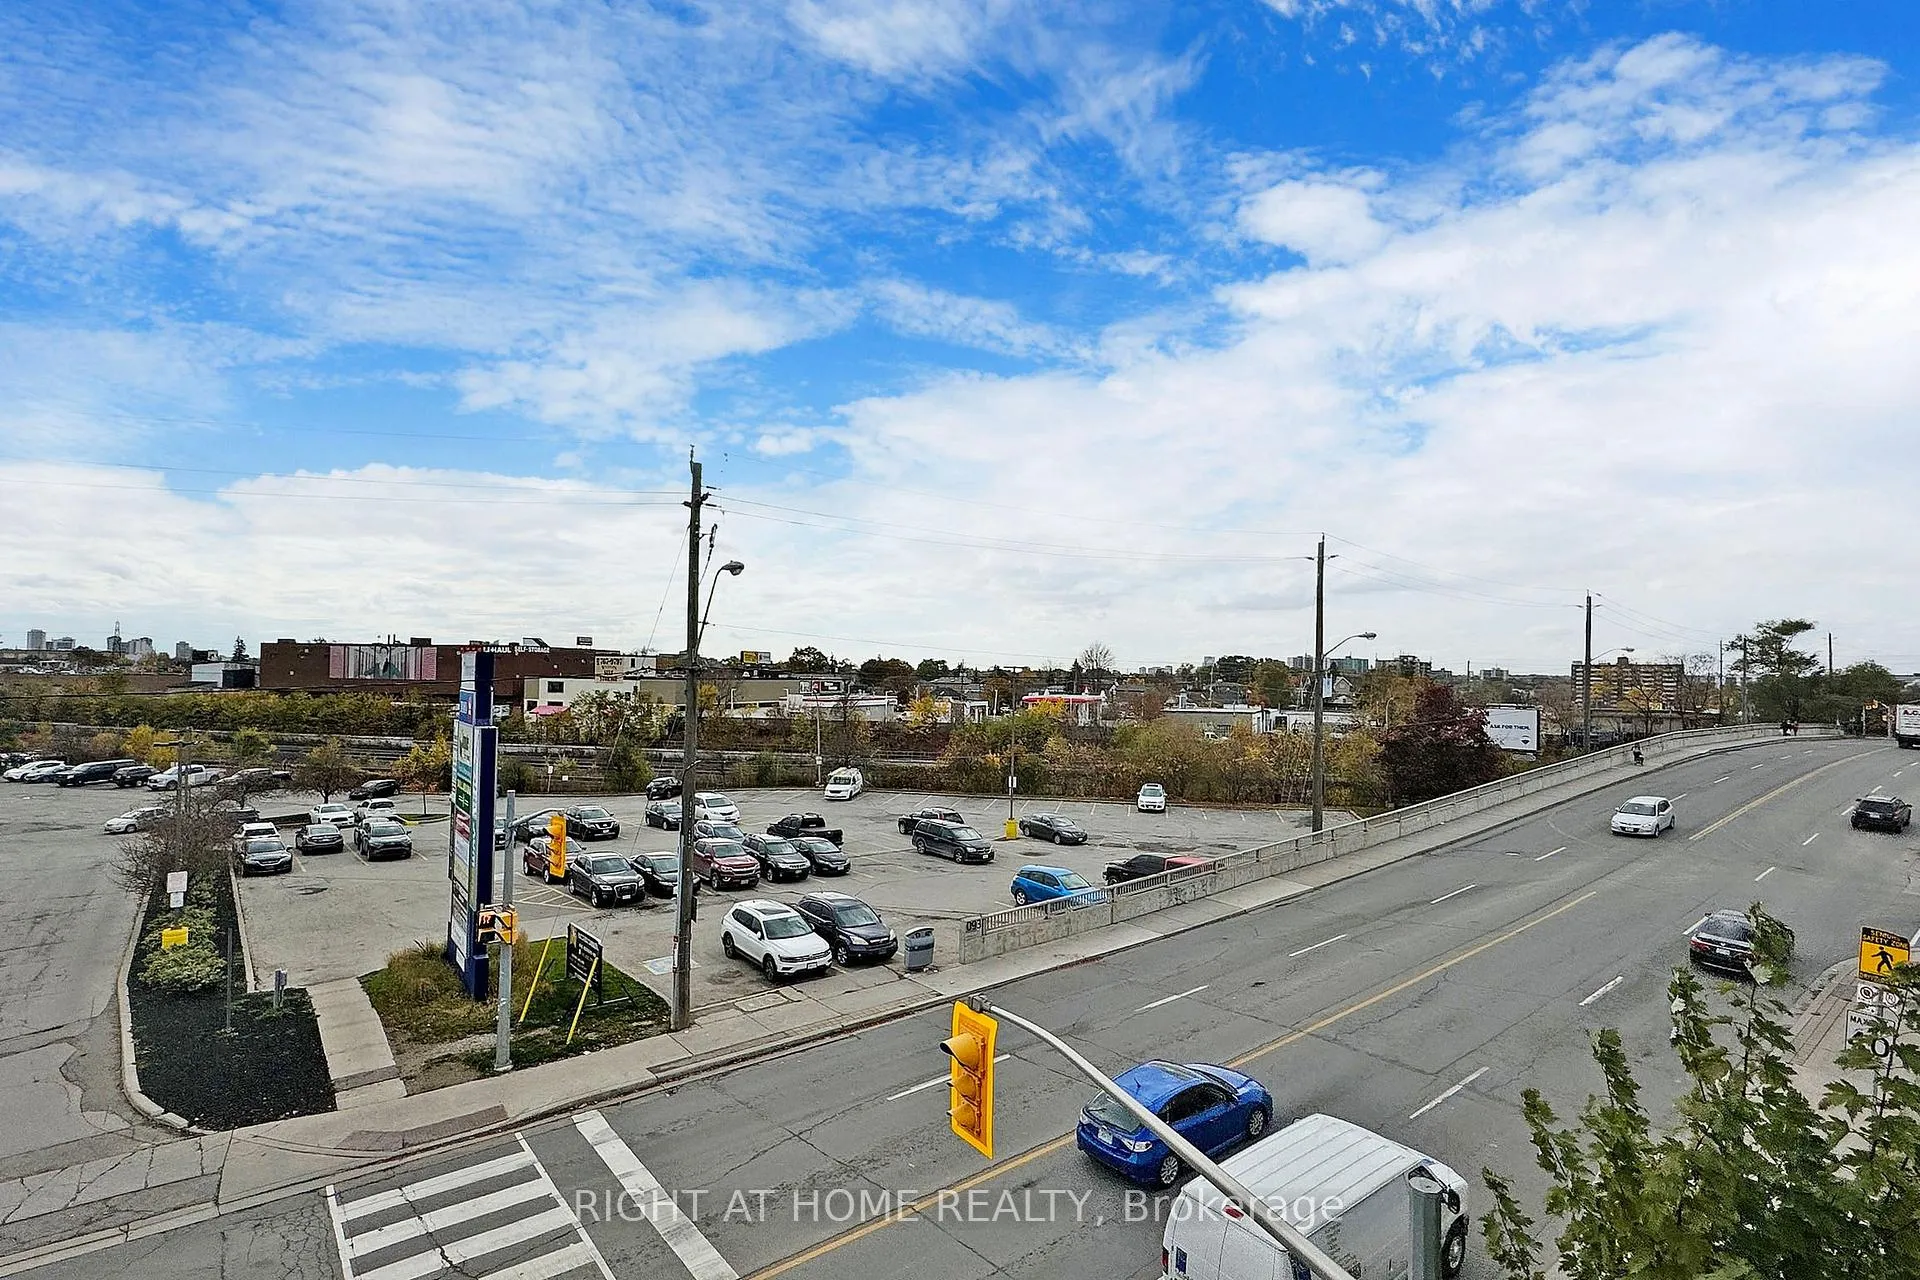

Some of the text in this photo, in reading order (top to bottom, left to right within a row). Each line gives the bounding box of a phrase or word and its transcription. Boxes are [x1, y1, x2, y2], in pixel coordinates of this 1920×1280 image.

[966, 919, 981, 931] 093
[1862, 934, 1909, 950] SAFETY ZONE
